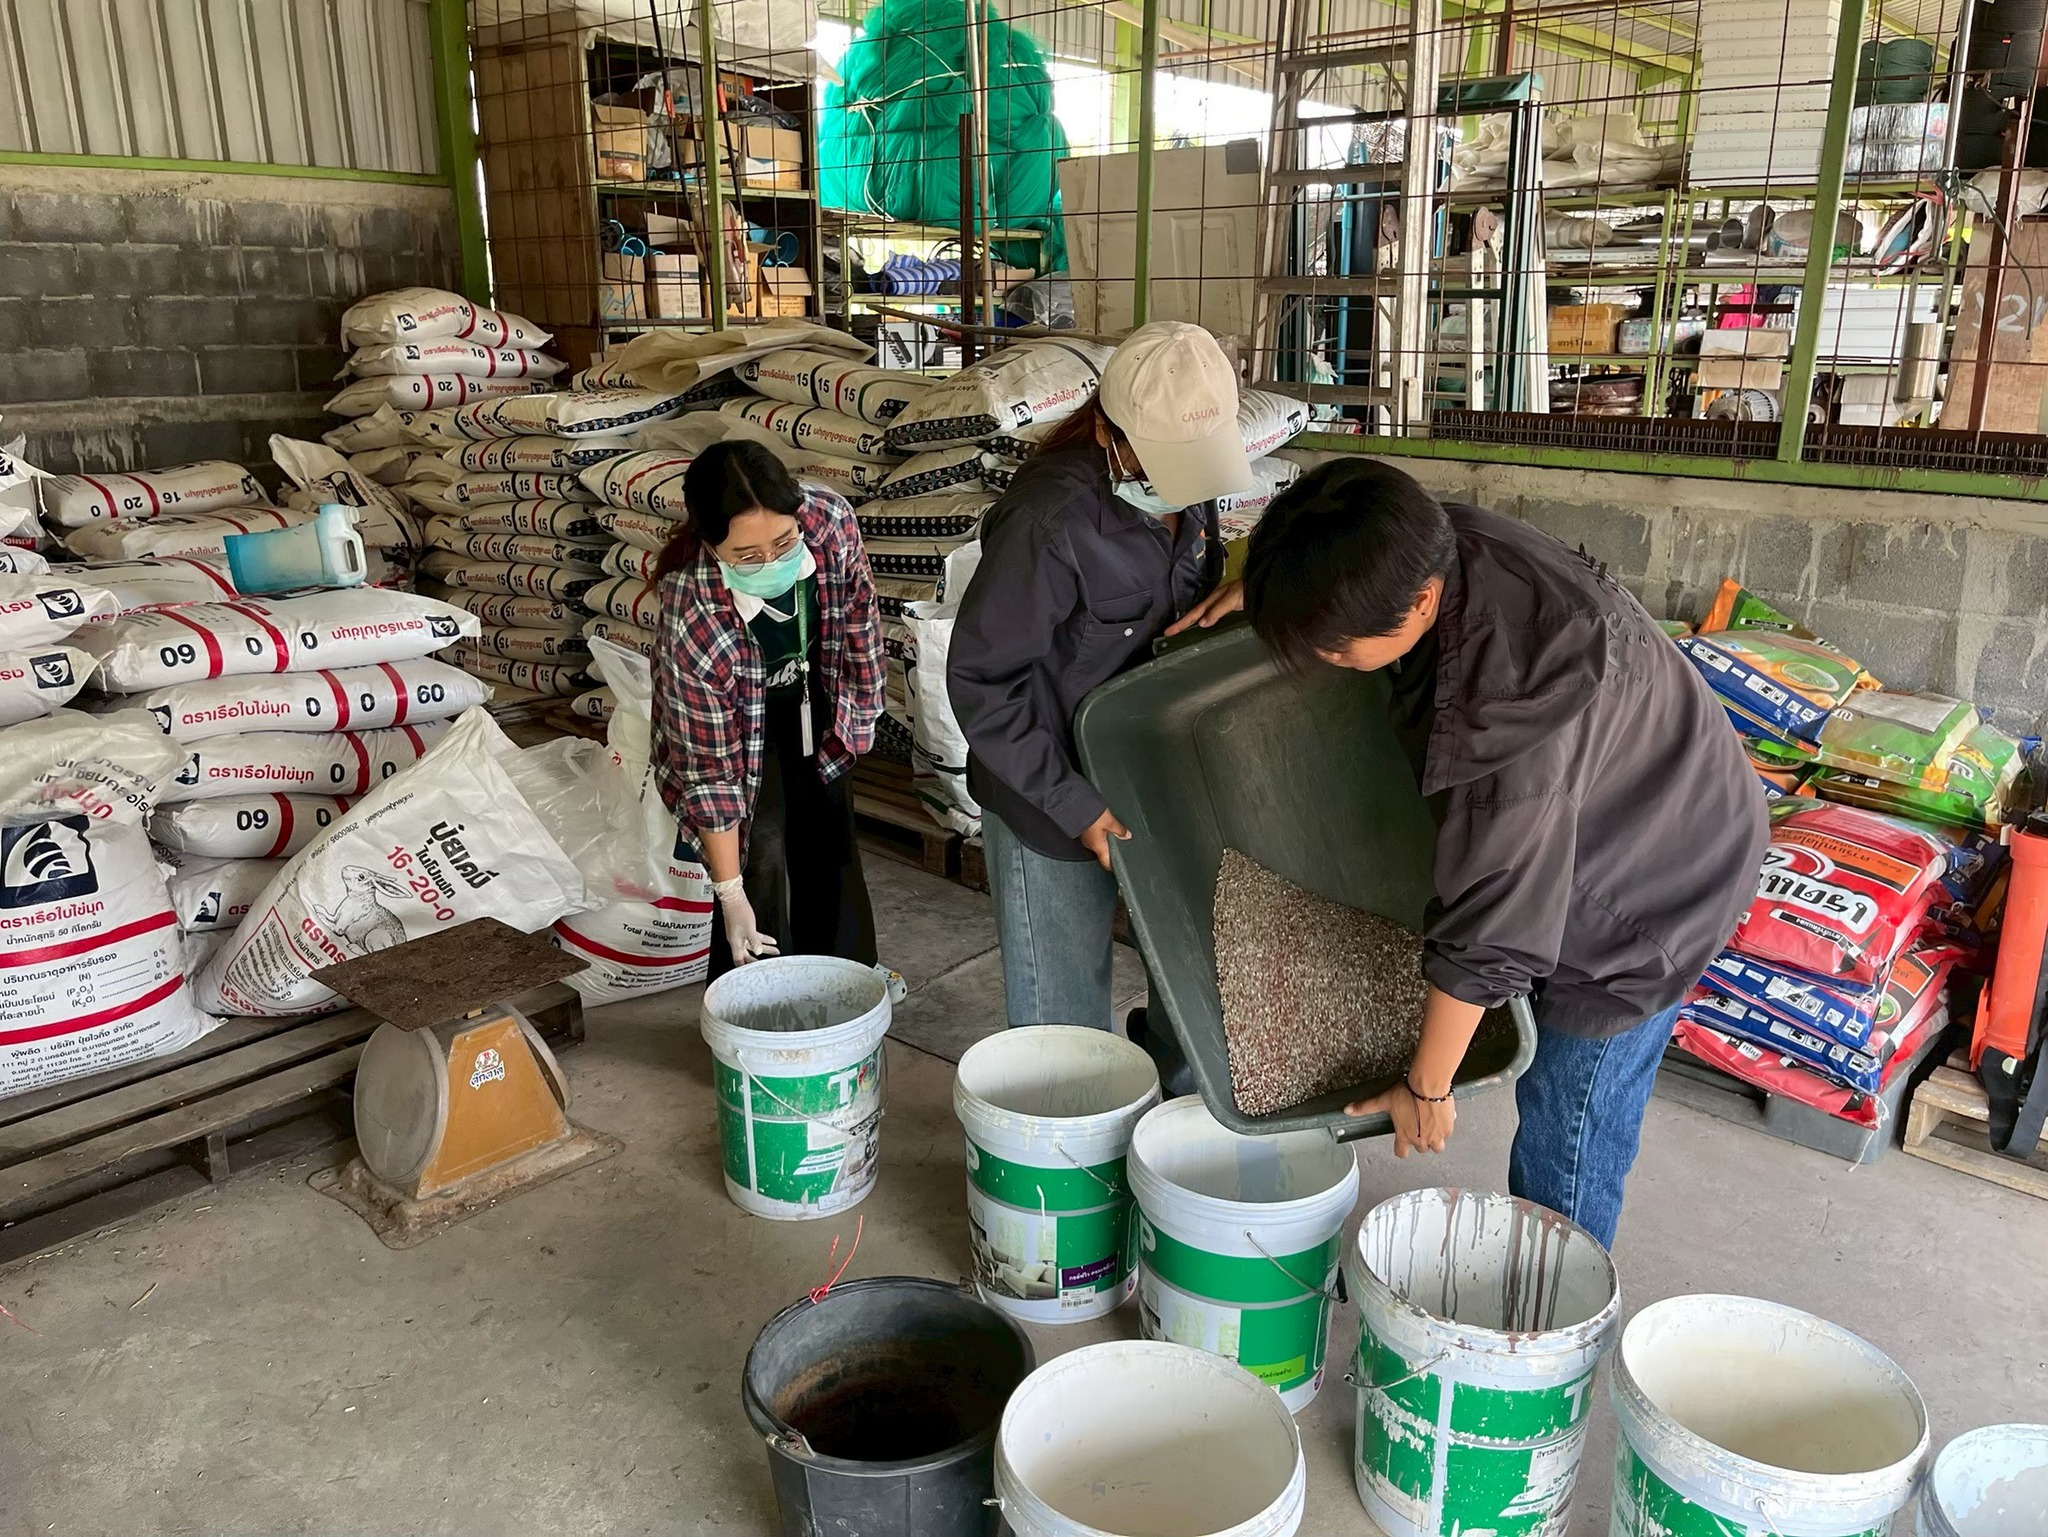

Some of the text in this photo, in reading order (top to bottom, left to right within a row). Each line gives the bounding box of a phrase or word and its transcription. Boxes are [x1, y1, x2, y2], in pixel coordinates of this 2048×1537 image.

[459, 305, 470, 317] 16
[482, 319, 497, 333] 20
[515, 328, 524, 339] 0
[471, 347, 485, 358] 16
[500, 351, 515, 362] 20
[531, 355, 539, 364] 0
[413, 381, 483, 393] 16 20 0
[796, 372, 809, 386] 15
[818, 378, 830, 393] 15
[844, 387, 856, 401] 15
[1081, 378, 1098, 397] 15
[1182, 407, 1220, 423] CASUAL
[776, 419, 788, 433] 15
[798, 422, 812, 437] 15
[467, 453, 477, 462] 15
[487, 453, 498, 462] 15
[506, 451, 516, 460] 15
[519, 479, 530, 492] 15
[610, 481, 623, 496] 15
[124, 496, 143, 510] 20
[163, 491, 181, 504] 16
[632, 491, 644, 504] 15
[654, 495, 667, 510] 15
[90, 504, 101, 517] 0
[1219, 498, 1233, 513] 15
[501, 515, 512, 527] 15
[518, 515, 528, 528] 15
[538, 518, 548, 531] 15
[472, 541, 482, 553] 15
[491, 541, 501, 553] 15
[508, 543, 519, 555] 15
[623, 559, 637, 572] 15
[496, 574, 506, 586] 15
[513, 575, 523, 587] 15
[534, 578, 545, 591] 15
[488, 604, 498, 616] 15
[505, 605, 515, 617] 15
[615, 602, 655, 626] 15 15
[331, 620, 424, 641] ตราเรือใบไข่มุก
[245, 636, 263, 656] 0
[300, 631, 318, 650] 0
[481, 635, 491, 647] 15
[499, 637, 510, 649] 15
[639, 642, 652, 657] 15
[497, 663, 508, 675] 15
[517, 666, 527, 678] 15
[540, 669, 550, 682] 15
[182, 683, 445, 726] ตราเรือใบไข่มุก 0 0 60
[208, 761, 397, 784] ตราเรือใบไข่มุก 0 0
[316, 808, 331, 827] 0
[425, 820, 500, 889] ปุ๋ยเคมี
[387, 844, 456, 922] 16-20-0
[1760, 873, 1868, 925] เรดแ
[0, 901, 105, 929] ตราเรือใบไข่มุก
[622, 923, 643, 937] Total
[644, 930, 678, 941] Nitrogen
[652, 919, 708, 930] GUARANTEED
[6, 920, 102, 946] น้ำหนักสุทธิ 50 กิโลกรัม
[3, 952, 118, 985] ปริมาณธาตุอาหารรับรอง
[79, 972, 92, 983] (N)
[154, 972, 163, 981] 60
[50, 1038, 75, 1051] บริษัท
[113, 1021, 135, 1034] จำกัด
